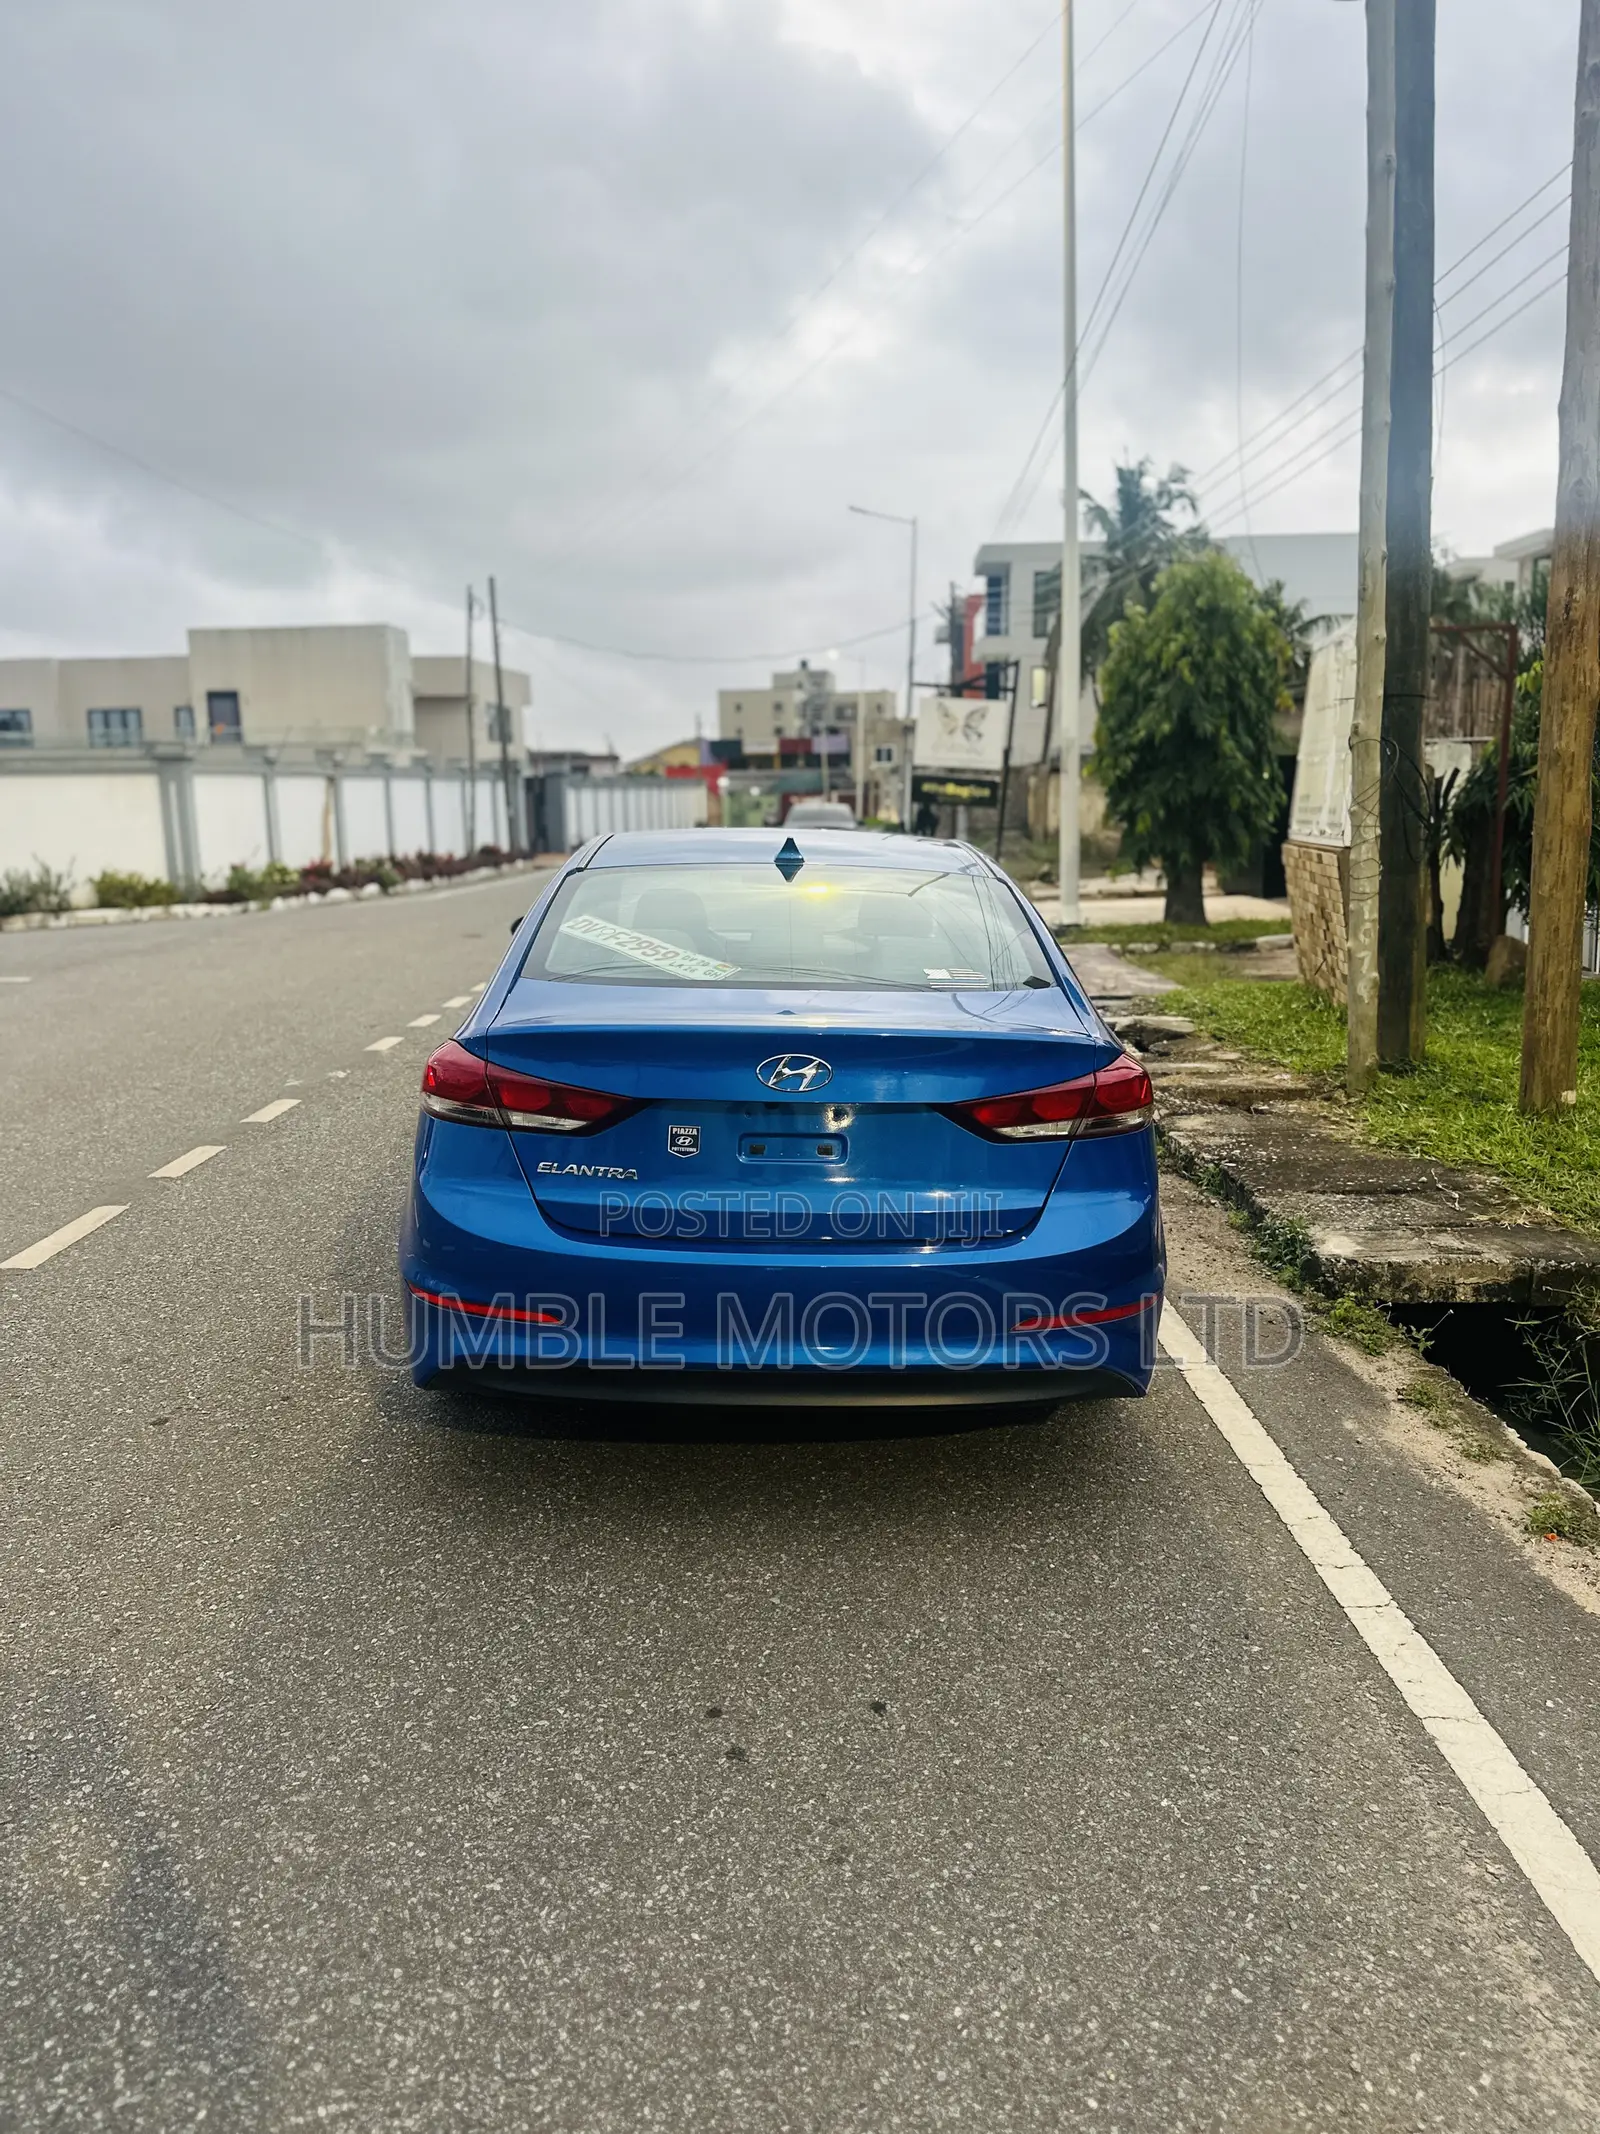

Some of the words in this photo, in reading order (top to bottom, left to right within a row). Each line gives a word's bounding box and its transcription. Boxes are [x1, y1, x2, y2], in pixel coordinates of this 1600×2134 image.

[601, 930, 681, 961] F2959
[672, 1127, 697, 1136] PIAZZA
[537, 1161, 638, 1180] ELANTRA
